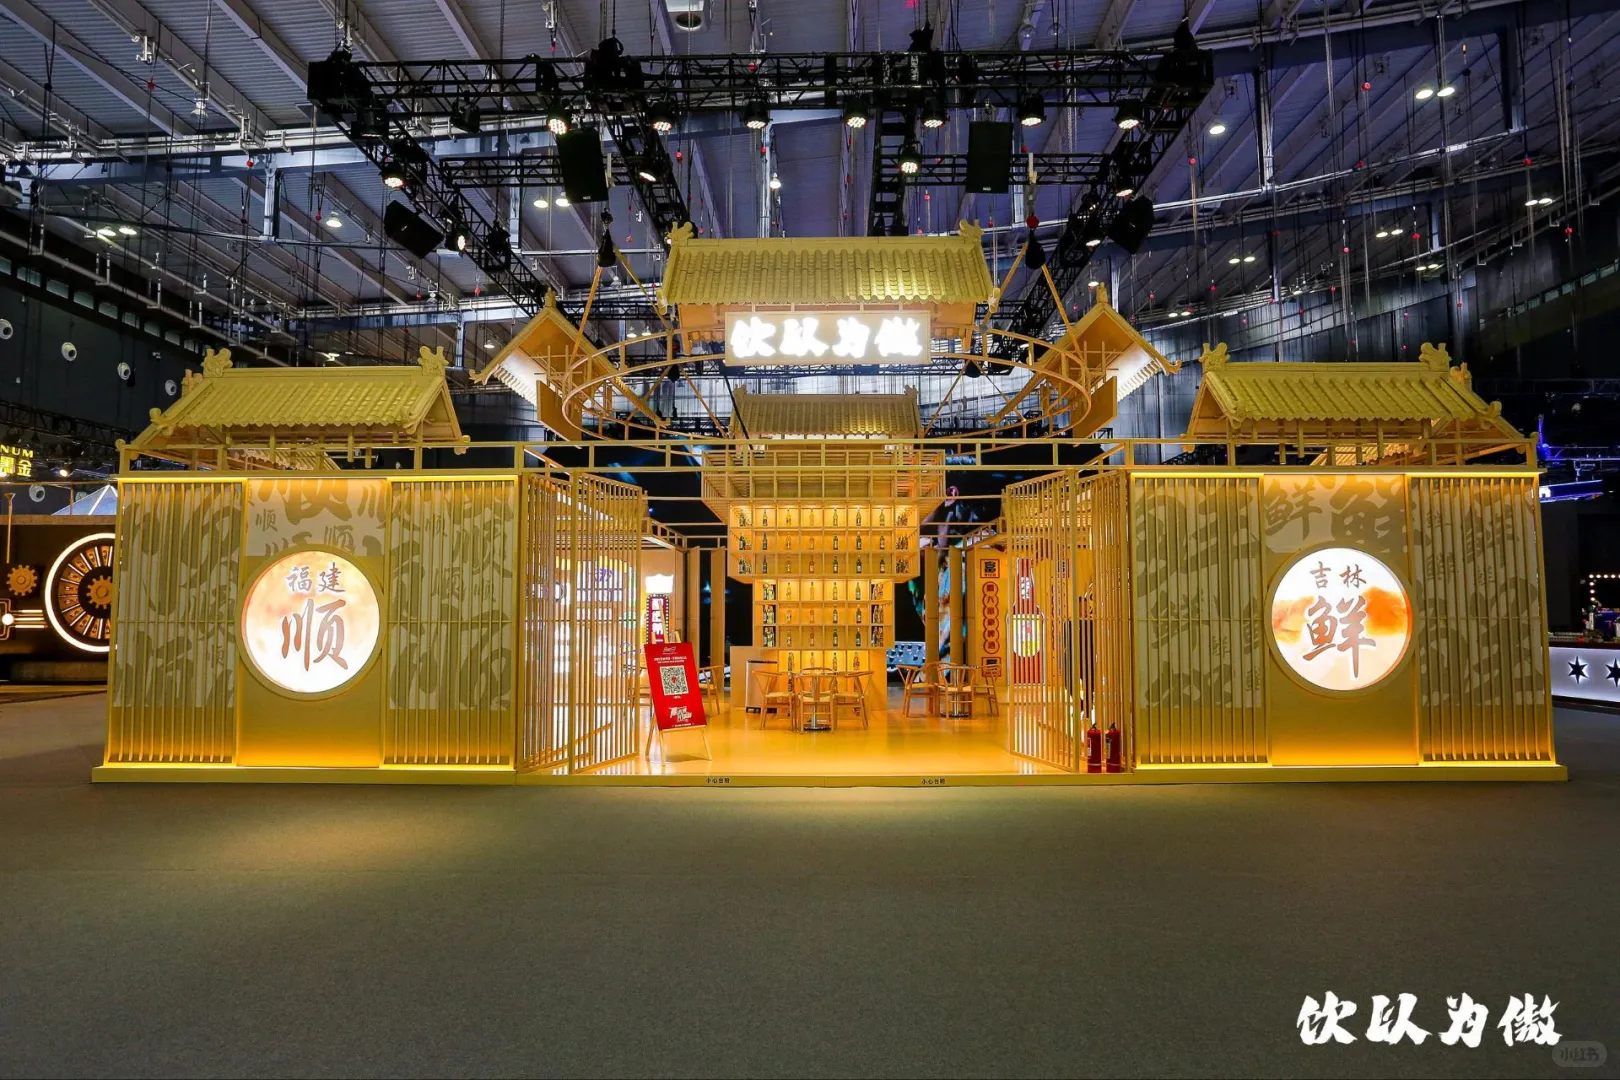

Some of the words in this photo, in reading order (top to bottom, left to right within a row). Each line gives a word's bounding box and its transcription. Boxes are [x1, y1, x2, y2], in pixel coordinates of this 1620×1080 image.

[255, 508, 278, 532] 顺
[286, 562, 346, 592] 福建
[1309, 561, 1367, 589] 吉林
[281, 598, 349, 672] 顺
[1302, 595, 1377, 679] 鲜
